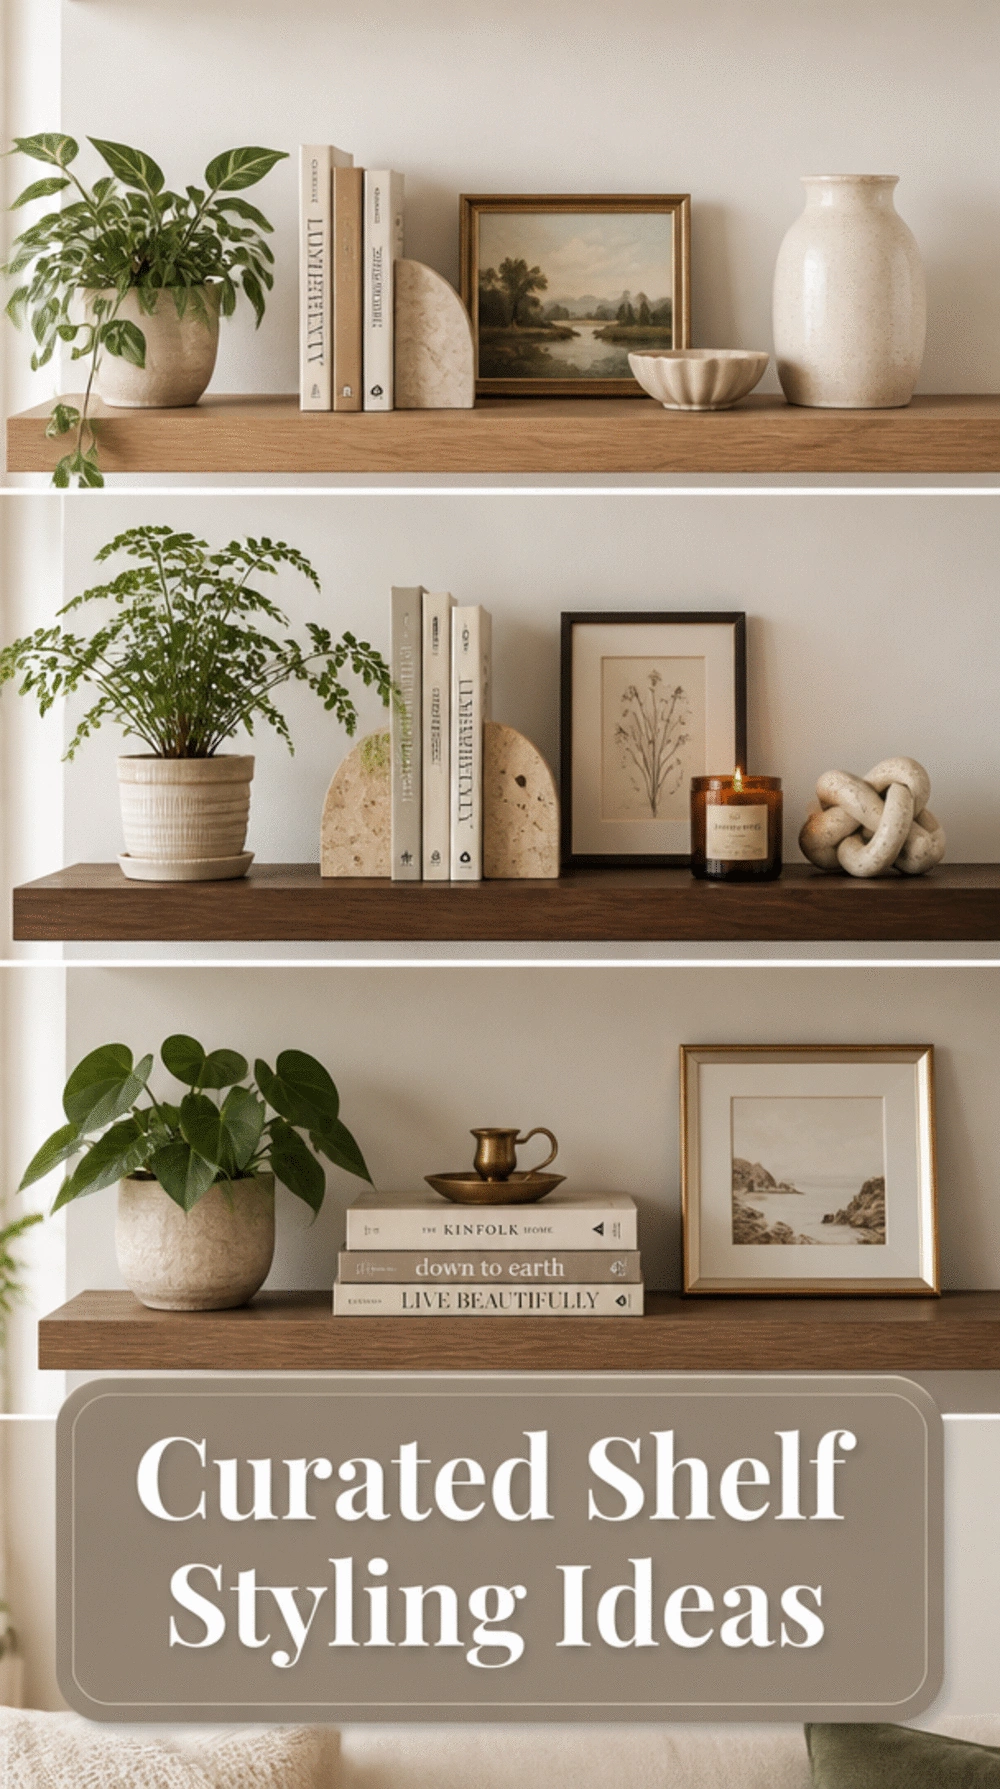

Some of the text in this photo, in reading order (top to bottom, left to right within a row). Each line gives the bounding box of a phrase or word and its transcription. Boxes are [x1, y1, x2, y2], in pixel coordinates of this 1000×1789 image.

[443, 1224, 519, 1236] KINFOLK
[415, 1257, 475, 1277] down
[481, 1260, 502, 1277] to
[508, 1257, 565, 1277] earth
[402, 1291, 600, 1309] LIVE BEAUTIFULLY
